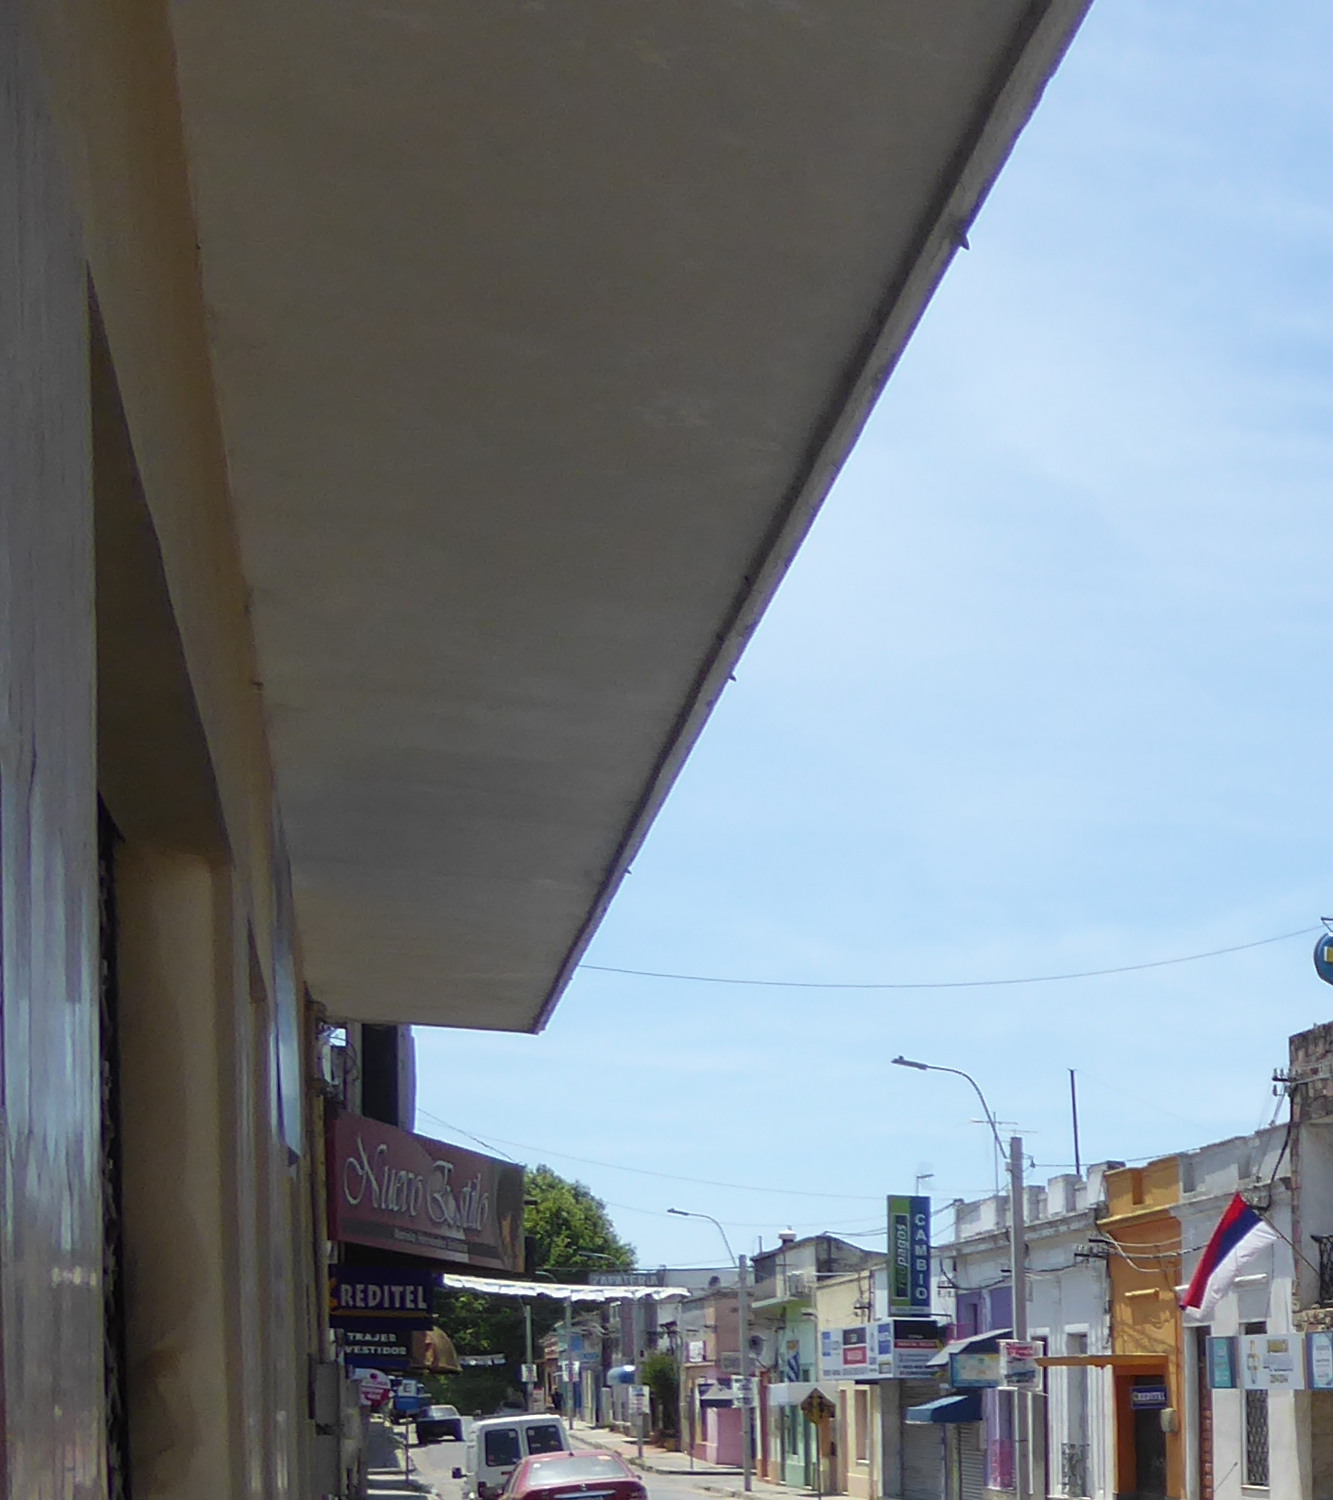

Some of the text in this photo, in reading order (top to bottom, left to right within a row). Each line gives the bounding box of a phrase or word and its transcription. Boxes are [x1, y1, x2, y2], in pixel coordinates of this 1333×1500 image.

[343, 1132, 490, 1232] Nuevo Estilo
[914, 1214, 928, 1299] CAMBIO
[345, 1345, 407, 1355] VESTIDOS
